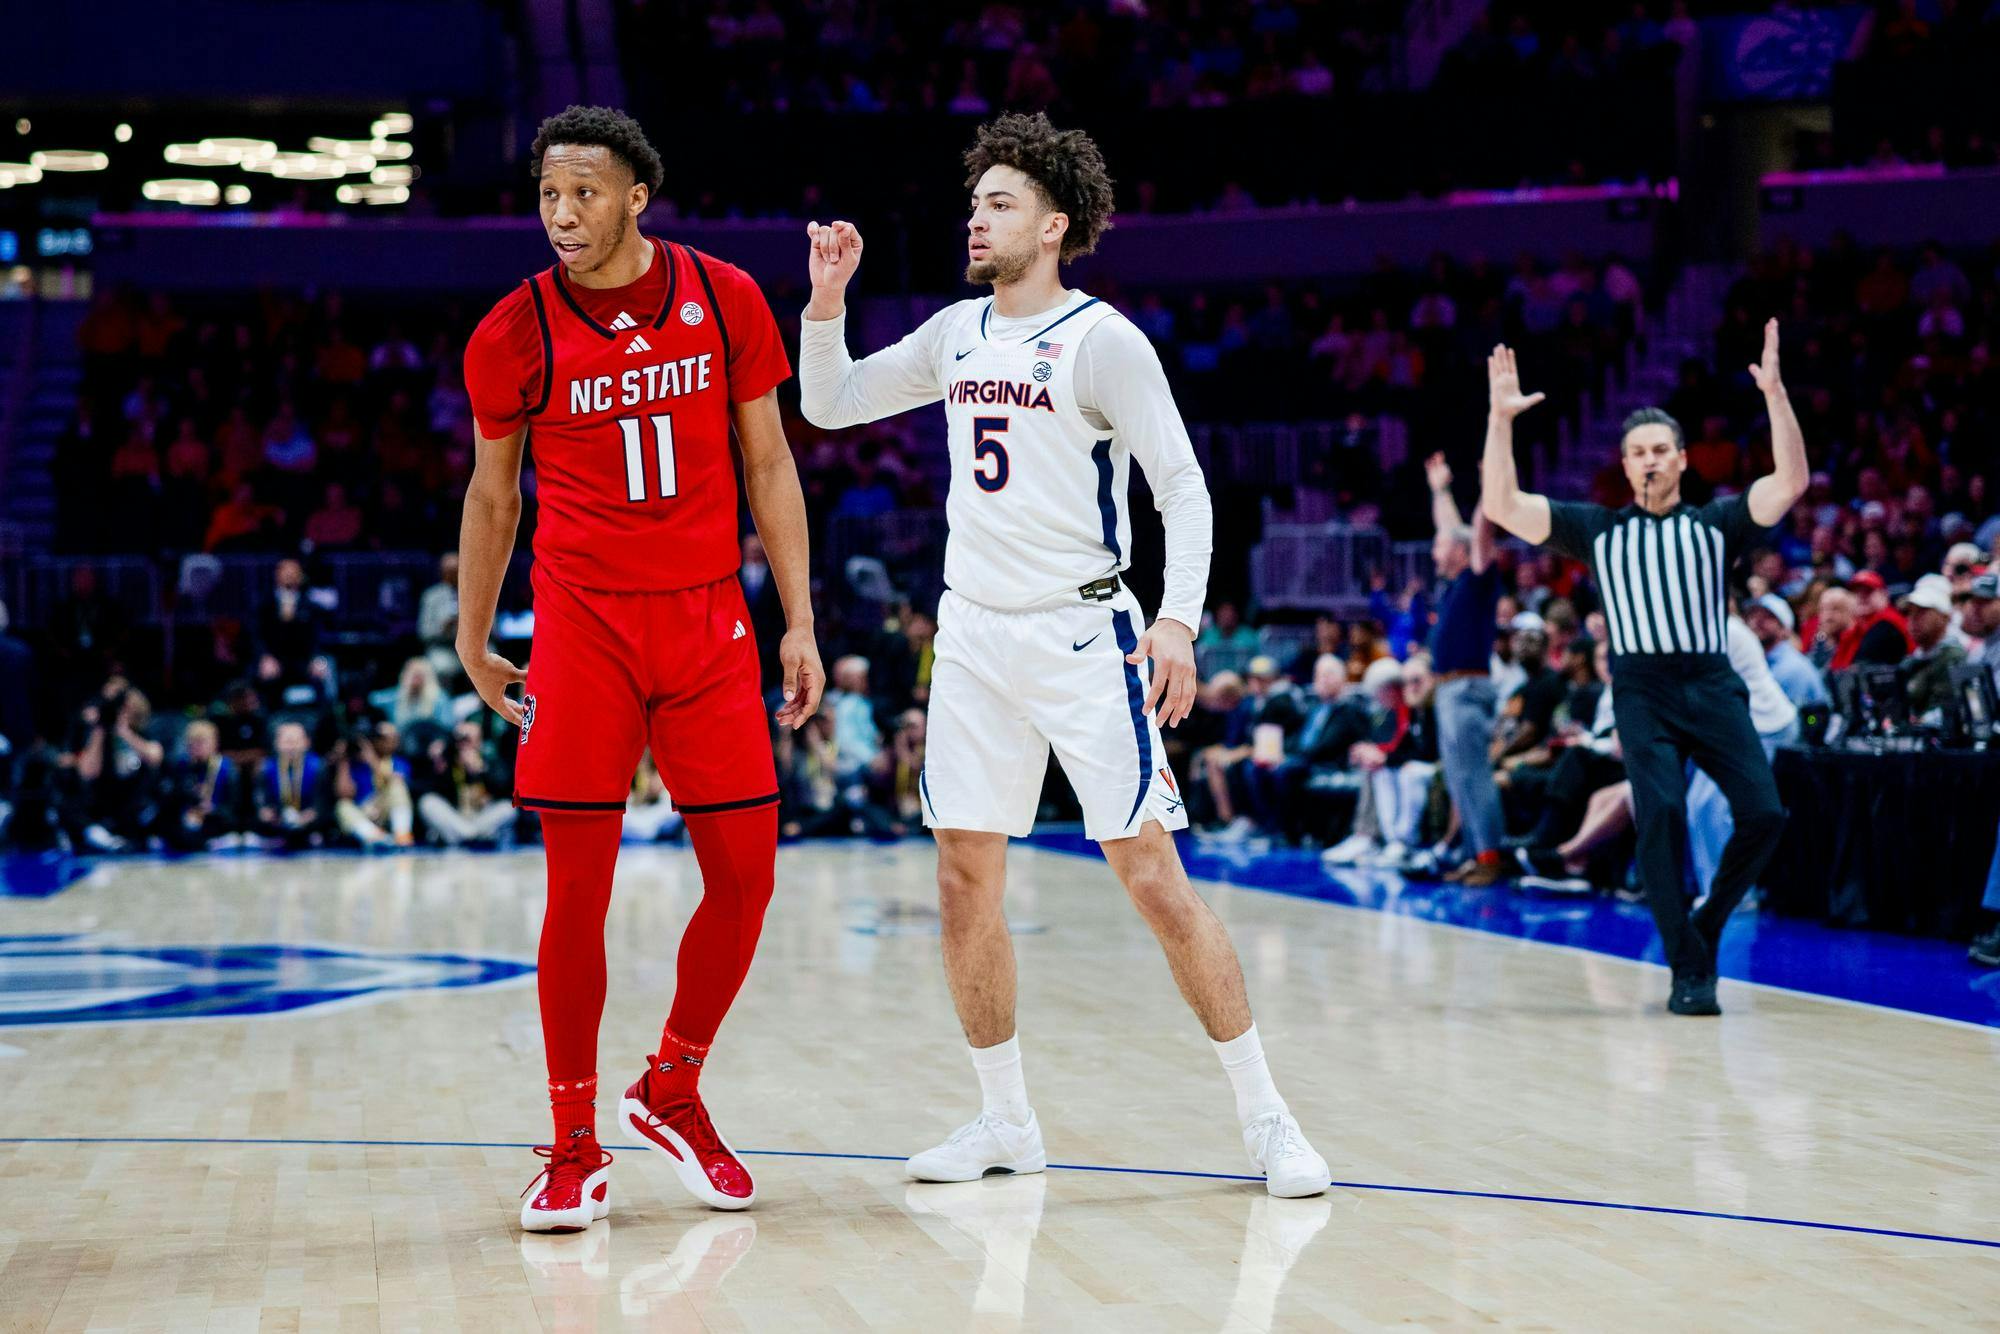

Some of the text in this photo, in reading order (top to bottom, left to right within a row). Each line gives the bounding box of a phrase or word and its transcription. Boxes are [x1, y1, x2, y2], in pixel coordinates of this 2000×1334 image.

[570, 353, 712, 415] NC STATE
[949, 380, 1055, 413] VIRGINIA
[616, 412, 678, 503] 11
[973, 416, 1010, 494] 5
